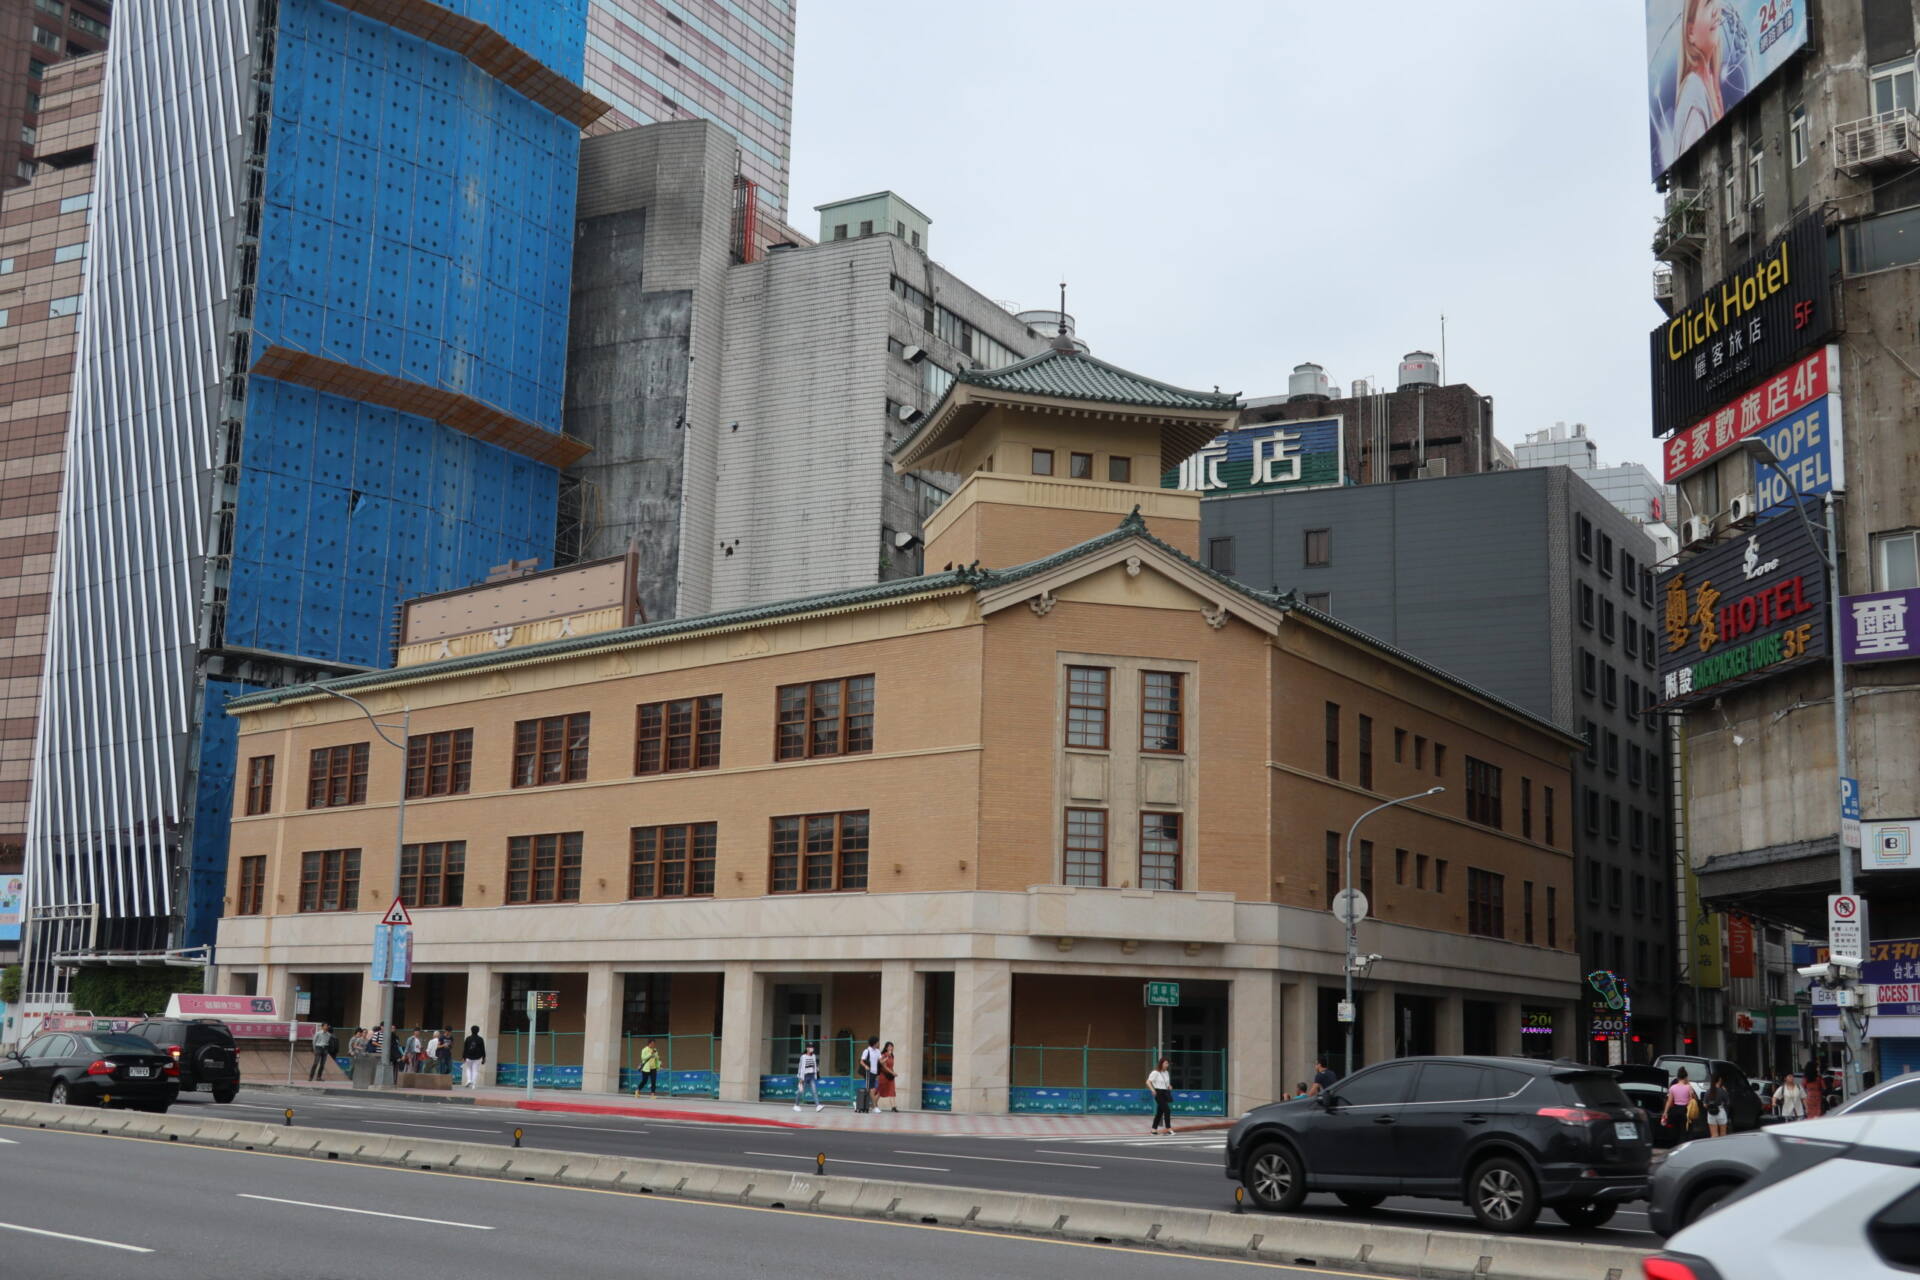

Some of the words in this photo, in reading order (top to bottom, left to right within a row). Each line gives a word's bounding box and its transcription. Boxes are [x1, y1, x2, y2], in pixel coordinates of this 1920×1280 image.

[1759, 0, 1777, 33] 24
[1668, 297, 1719, 361] Click
[1722, 241, 1789, 326] Hotel
[1793, 300, 1813, 330] 5F
[1758, 453, 1829, 513] HOTEL
[1719, 575, 1813, 642] HOTEL
[1691, 646, 1748, 690] BACKPACKER
[1751, 633, 1783, 671] HOUSE
[1783, 624, 1812, 659] 3F
[1841, 779, 1852, 806] P
[256, 1001, 272, 1011] Z6
[1876, 984, 1908, 1003] CCESS
[1592, 1020, 1624, 1030] 200
